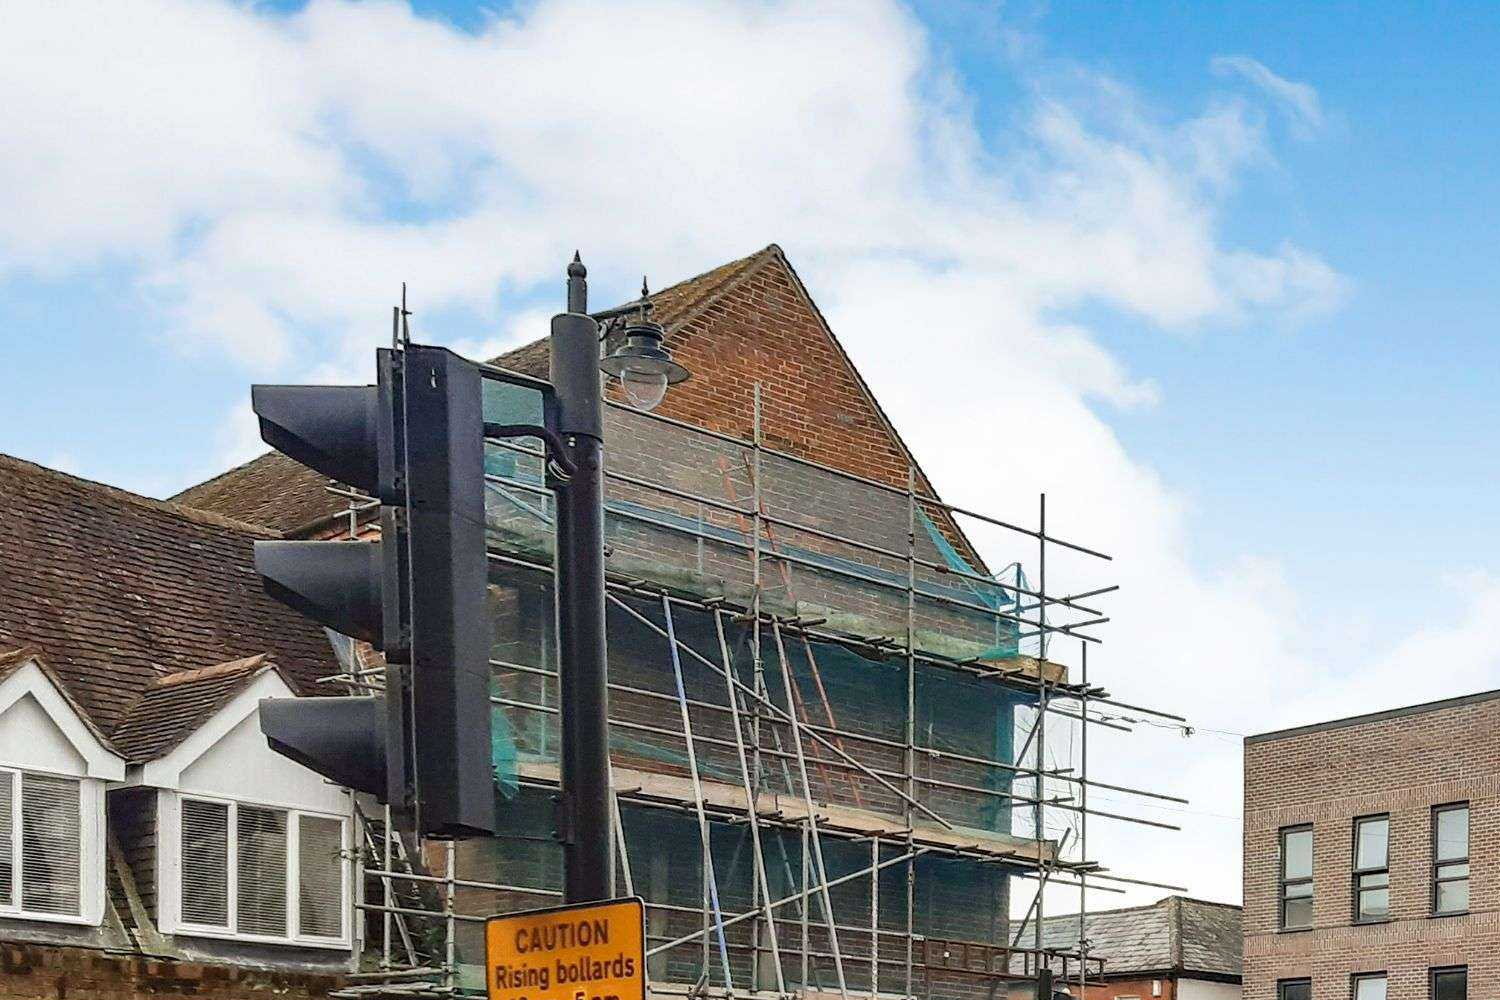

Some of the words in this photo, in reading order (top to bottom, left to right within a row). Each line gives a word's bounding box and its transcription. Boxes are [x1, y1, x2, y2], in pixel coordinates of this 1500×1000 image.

[515, 919, 609, 953] CAUTION
[495, 963, 550, 990] Rising
[556, 953, 635, 984] bollards
